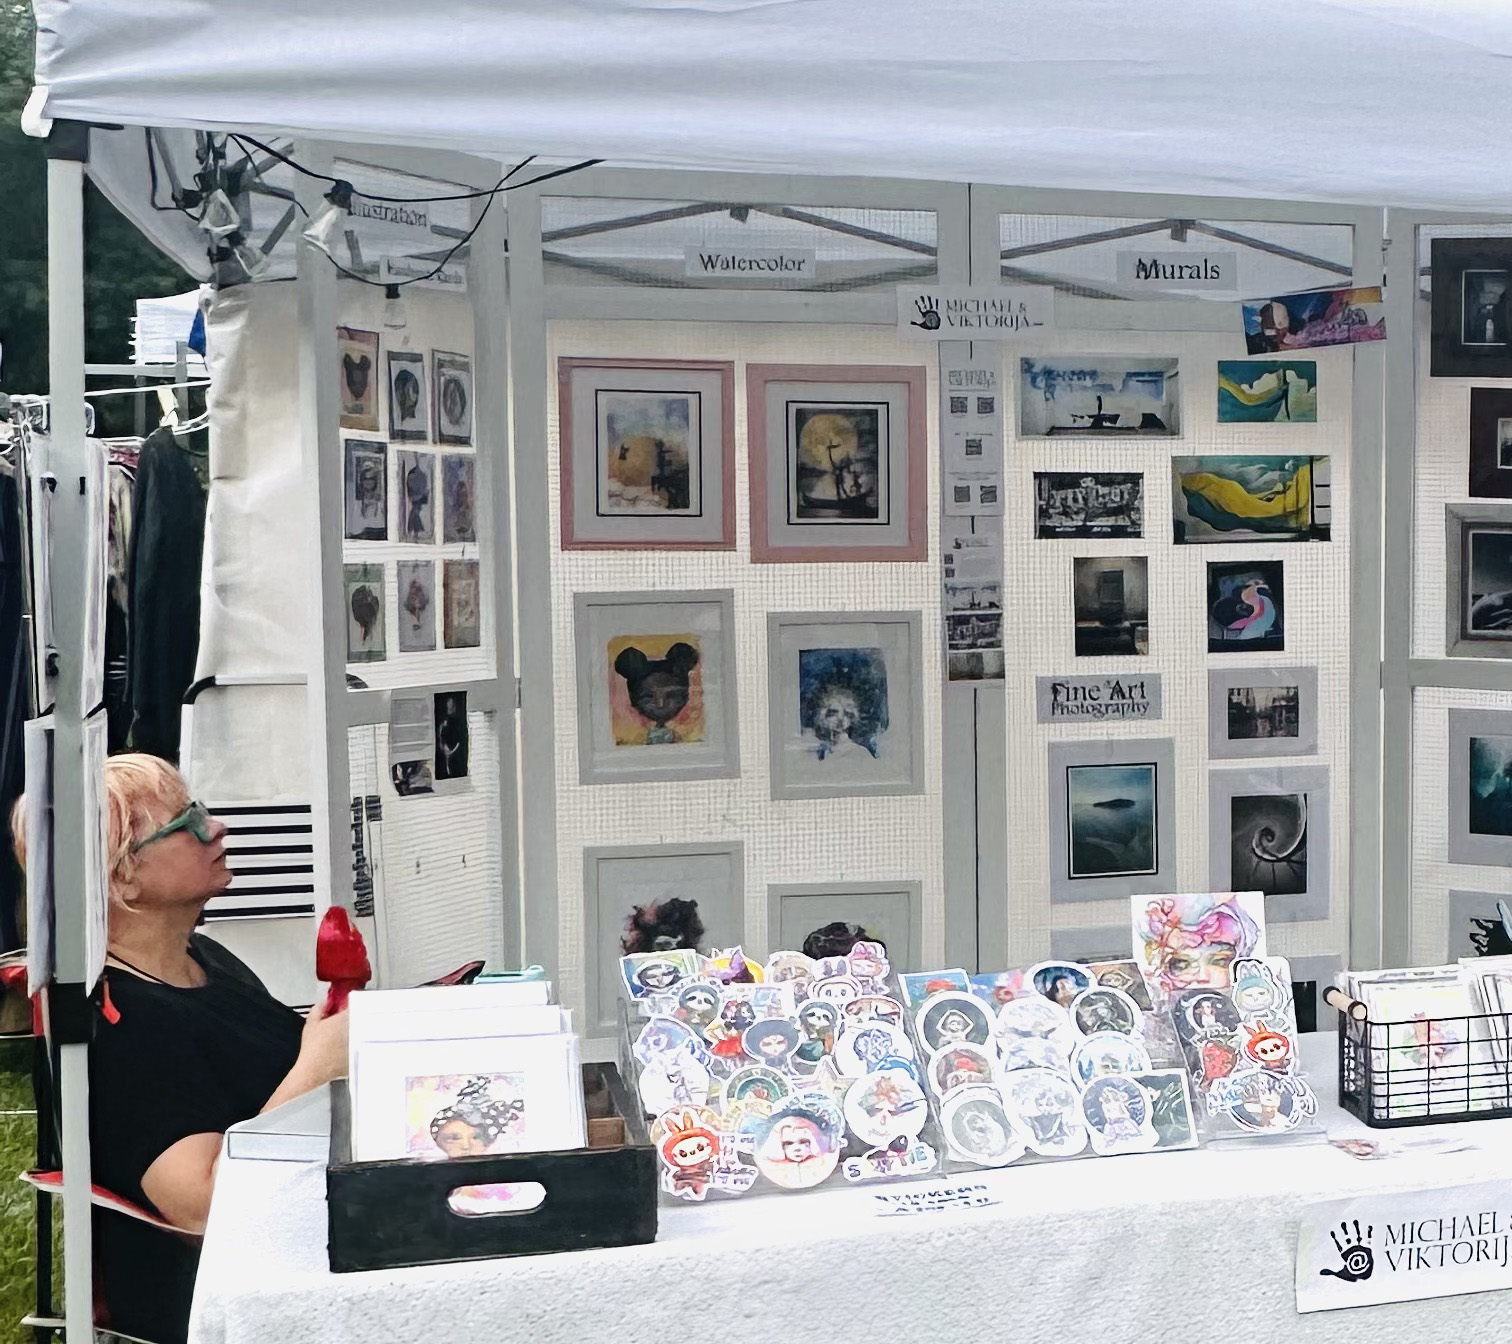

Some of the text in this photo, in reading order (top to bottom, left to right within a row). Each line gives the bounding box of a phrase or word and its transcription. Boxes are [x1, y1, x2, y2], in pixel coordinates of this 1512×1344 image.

[699, 253, 806, 272] Watercolor
[1136, 258, 1220, 280] Murals
[1050, 679, 1147, 702] Fine Art
[1051, 699, 1149, 719] Photography
[1384, 1212, 1504, 1246] MICHAEL
